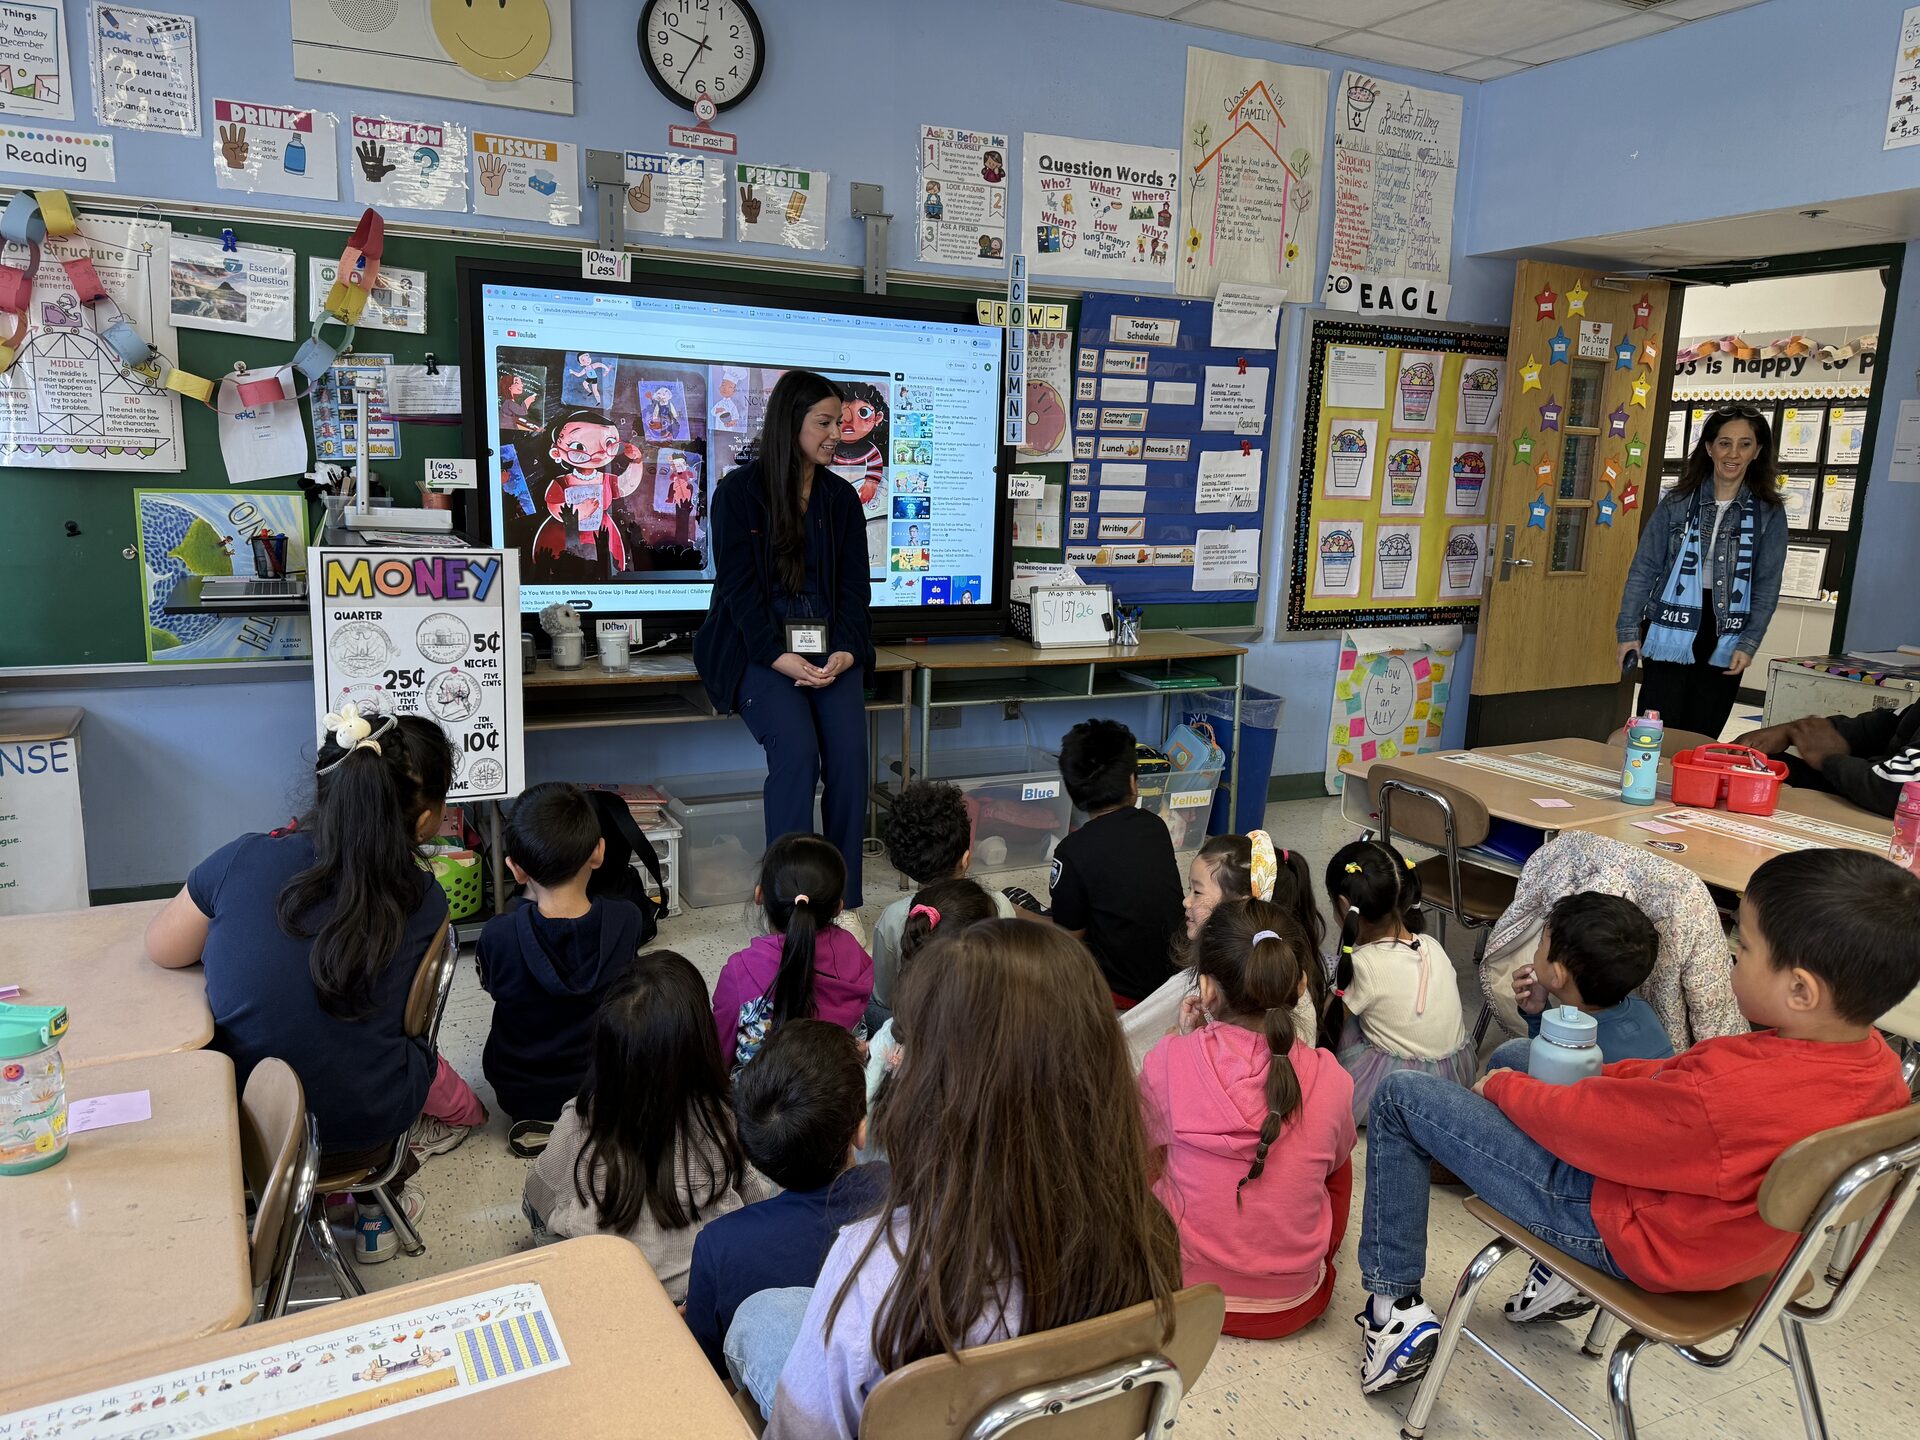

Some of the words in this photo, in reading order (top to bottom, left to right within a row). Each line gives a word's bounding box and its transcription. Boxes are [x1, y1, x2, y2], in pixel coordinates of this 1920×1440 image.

[3, 8, 37, 21] Things
[662, 12, 679, 27] 10
[718, 7, 723, 20] 1
[14, 27, 48, 40] Monday
[658, 31, 668, 45] 9
[729, 25, 739, 39] 2
[0, 37, 45, 49] December
[24, 53, 54, 64] Canyon
[112, 46, 144, 58] Change
[154, 54, 176, 63] word
[734, 45, 744, 59] 3
[663, 53, 673, 67] 8
[728, 65, 738, 78] 4
[695, 80, 706, 93] 6
[715, 77, 725, 91] 5
[138, 86, 152, 95] out
[162, 90, 187, 100] detail
[1223, 86, 1250, 113] Class
[1267, 83, 1286, 109] 1-131
[1400, 90, 1413, 109] A
[149, 106, 163, 115] the
[164, 109, 190, 119] order
[229, 103, 299, 130] DRINK
[700, 105, 712, 115] 30
[1240, 107, 1272, 122] FAMILY
[1385, 103, 1413, 123] Bucket
[1414, 108, 1439, 135] Filling
[682, 132, 700, 144] half
[703, 137, 724, 148] past
[926, 127, 945, 138] Ask
[947, 130, 954, 140] 3
[957, 131, 989, 145] Before
[992, 136, 1004, 147] Me
[485, 137, 547, 160] TISSUE
[928, 144, 934, 160] 1
[954, 143, 981, 152] YOURSELF
[6, 144, 87, 172] Reading
[1340, 150, 1371, 172] Sharing
[1039, 155, 1111, 178] Question
[1116, 166, 1163, 186] Words
[746, 167, 801, 188] PENCIL
[1041, 178, 1071, 189] Who?
[509, 182, 526, 190] paper
[962, 185, 985, 193] AROUND
[1090, 181, 1121, 197] What?
[993, 193, 1002, 209] 2
[1132, 191, 1170, 201] Where?
[1041, 211, 1077, 229] When?
[1094, 220, 1117, 232] How
[925, 226, 935, 242] 3
[958, 225, 979, 233] FRIEND
[1141, 224, 1168, 240] Why?
[1083, 232, 1104, 242] long?
[1105, 234, 1130, 248] many?
[44, 243, 124, 261] Structure
[1084, 248, 1100, 259] tall?
[1102, 251, 1126, 259] much?
[1099, 242, 1115, 252] big?
[229, 263, 236, 272] 7
[249, 262, 288, 275] Essential
[590, 263, 615, 276] Less
[248, 274, 289, 287] Question
[250, 290, 261, 298] How
[272, 293, 289, 302] things
[996, 305, 1042, 325] ROW
[1131, 320, 1158, 331] Today's
[517, 331, 537, 339] YouTube
[1127, 332, 1160, 341] Schedule
[1314, 327, 1341, 336] CHOOSE
[1343, 329, 1377, 339] POSITIVITY!
[1382, 333, 1401, 341] LEARN
[1403, 335, 1438, 344] SOMETHING
[1581, 333, 1591, 342] The
[1592, 335, 1609, 344] Stars
[1008, 282, 1022, 417] COLUMN
[1581, 346, 1589, 355] Of
[1590, 347, 1605, 356] 1-131
[50, 360, 84, 369] MIDDLE
[1706, 356, 1722, 374] is
[1733, 355, 1807, 378] happy
[124, 396, 141, 405] END
[234, 410, 256, 421] epic!
[1238, 416, 1260, 433] Reading
[1101, 444, 1124, 452] Lunch
[1146, 445, 1169, 453] Recess
[431, 469, 458, 481] Less
[1010, 489, 1030, 497] More
[1102, 524, 1128, 533] Writing
[1067, 552, 1085, 560] Pack
[1086, 553, 1097, 562] Up
[1115, 552, 1136, 560] Snack
[326, 556, 500, 602] MONEY
[1233, 574, 1254, 586] Writing
[639, 589, 654, 597] Along
[334, 611, 382, 621] QUARTER
[1660, 609, 1690, 624] 2015
[474, 631, 501, 653] 5¢
[464, 659, 497, 668] NICKEL
[383, 668, 426, 690] 25¢
[1375, 682, 1384, 695] to
[1390, 683, 1400, 695] be
[1380, 699, 1390, 707] an
[1372, 709, 1395, 726] ALLY
[474, 722, 493, 730] CENTS
[464, 729, 500, 753] 10¢
[450, 781, 469, 790] IME
[1024, 788, 1054, 798] Blue
[1171, 794, 1209, 806] Yellow
[411, 1344, 421, 1358] d
[379, 1354, 390, 1367] b
